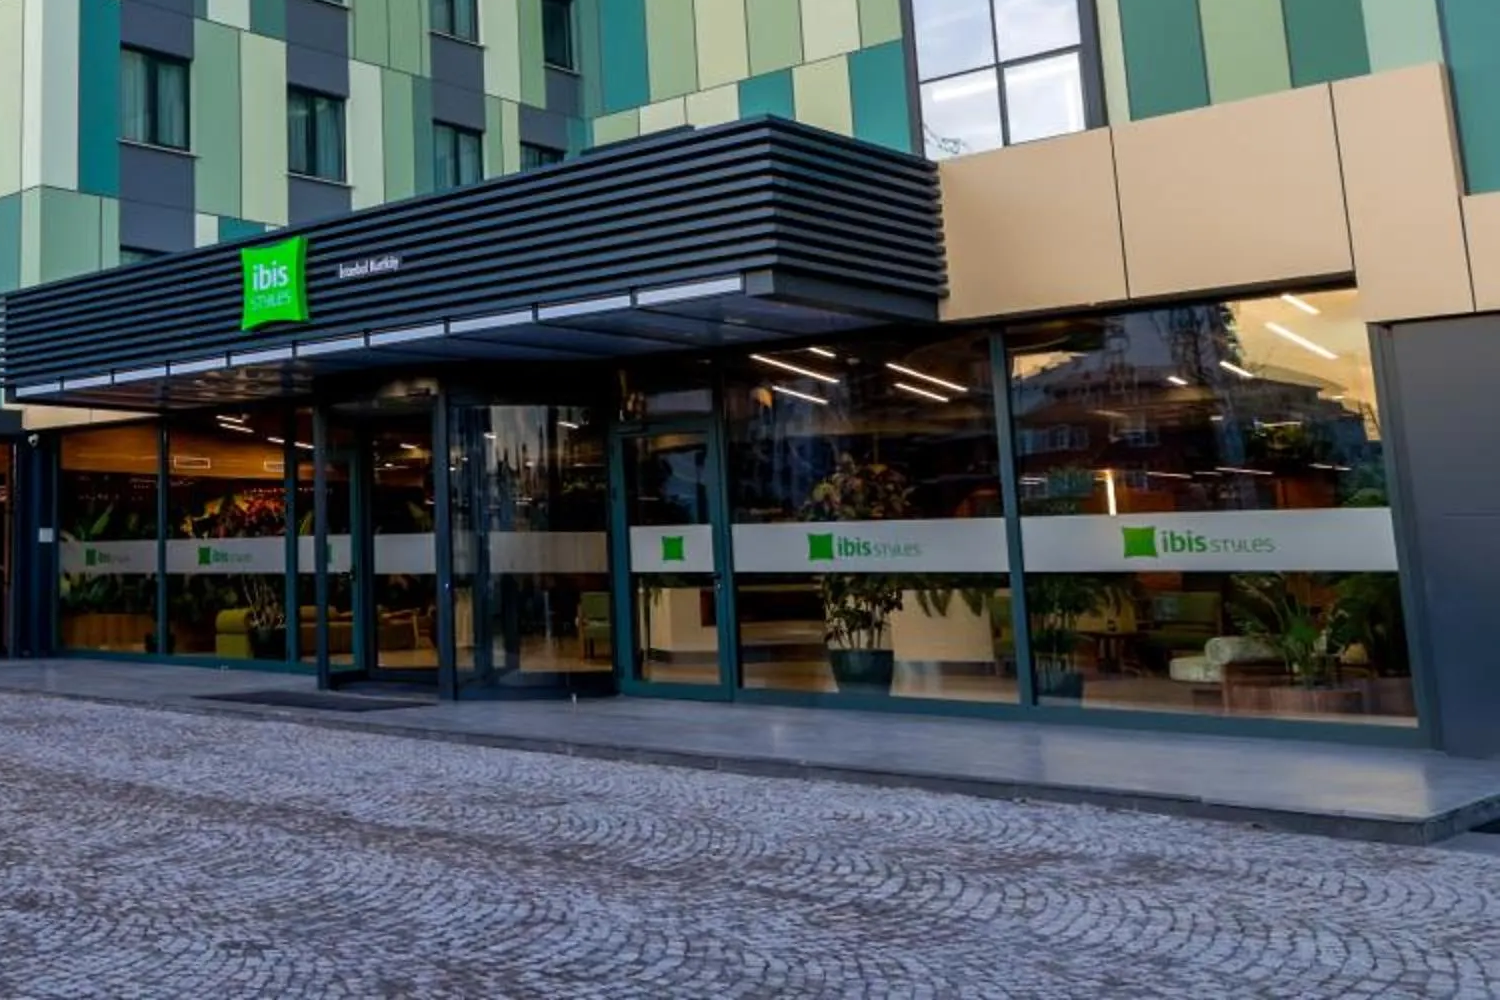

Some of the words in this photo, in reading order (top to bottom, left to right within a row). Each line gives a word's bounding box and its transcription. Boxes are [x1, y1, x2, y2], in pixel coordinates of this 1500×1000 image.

[252, 260, 288, 291] ibis
[837, 535, 871, 557] ibis
[1161, 530, 1207, 552] ibis
